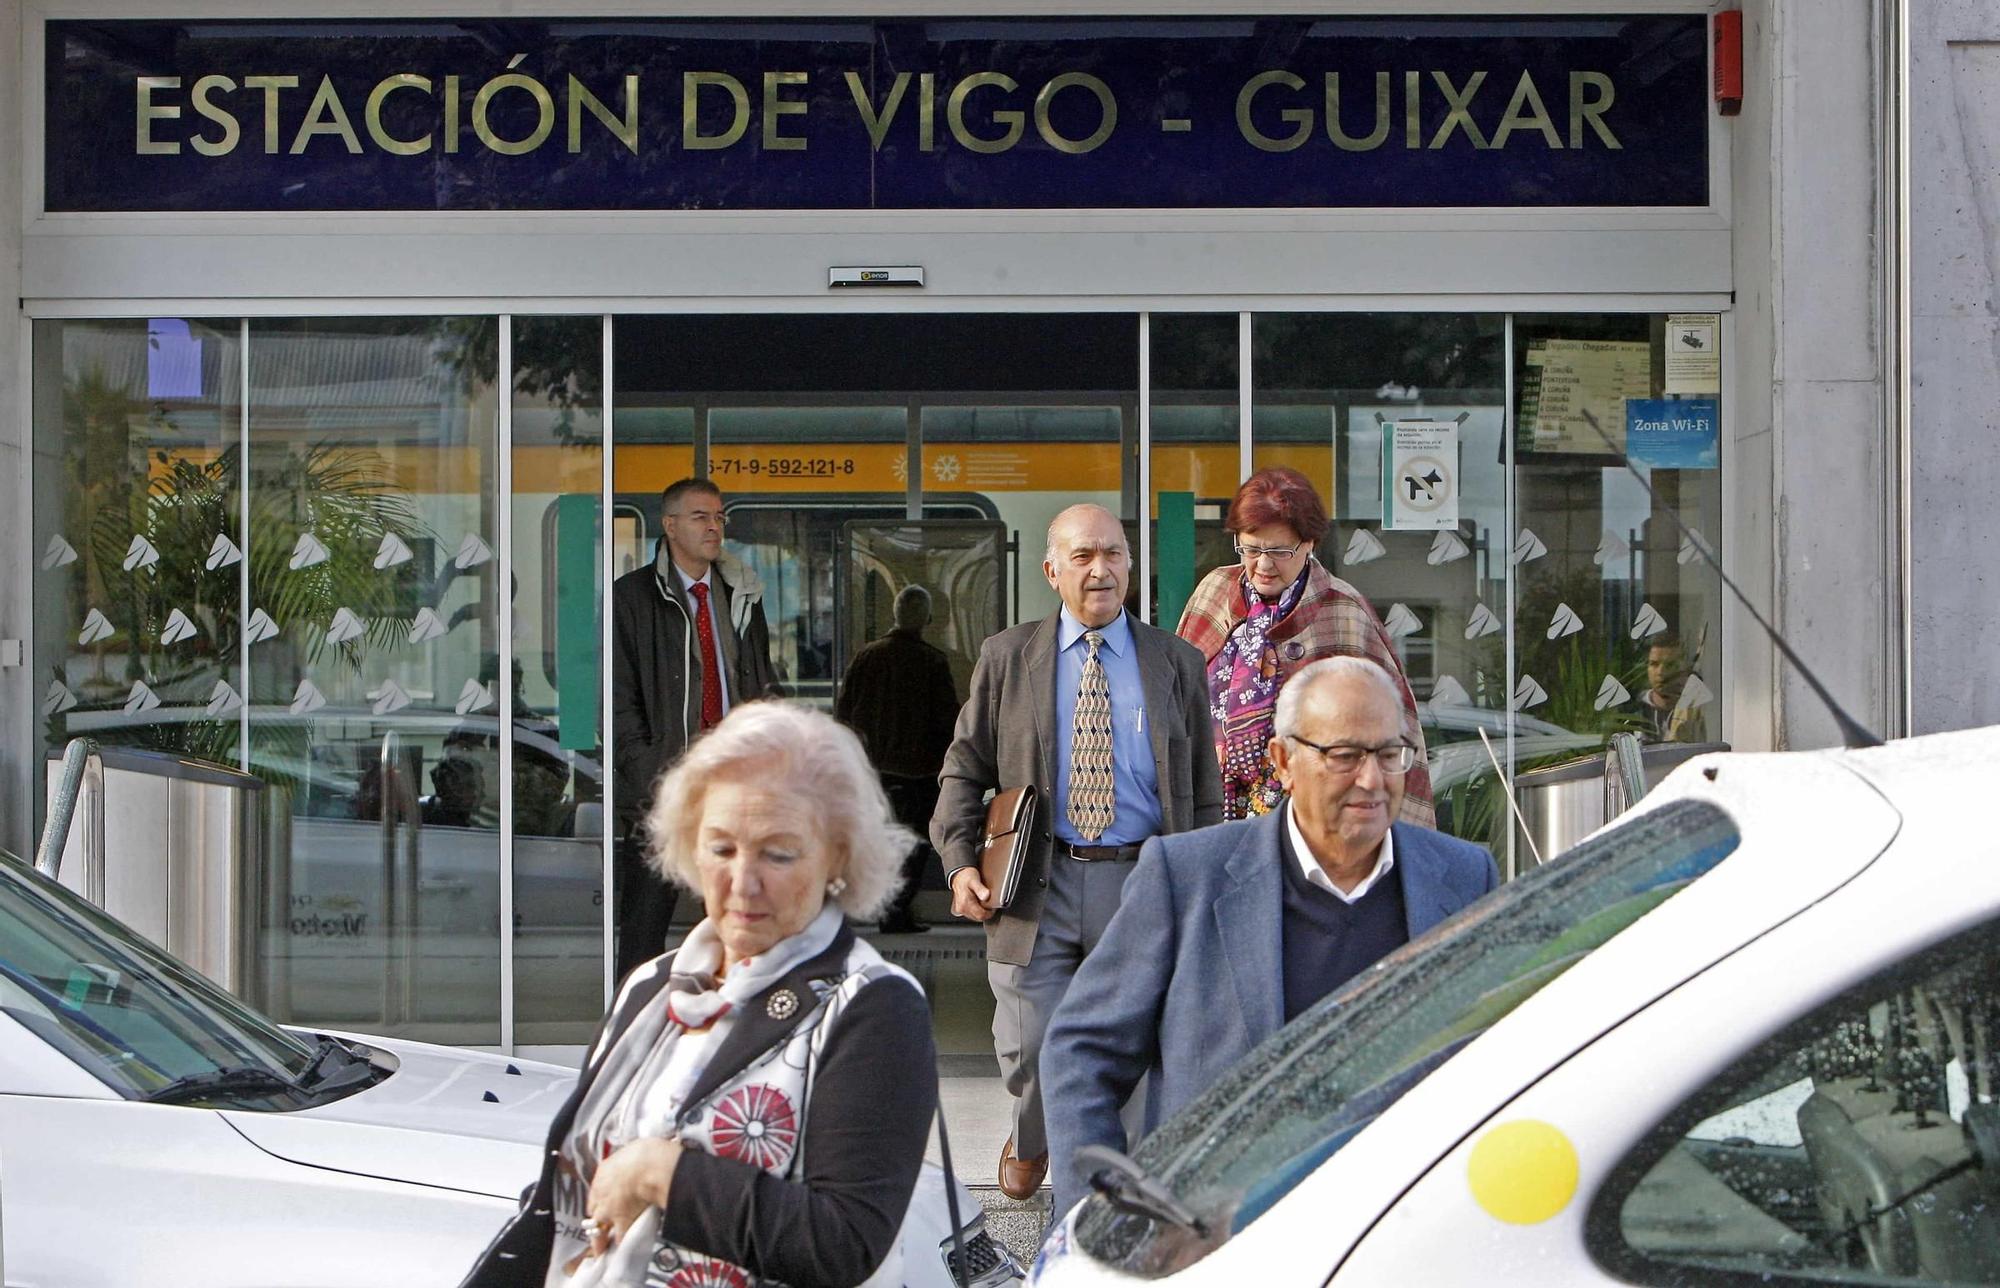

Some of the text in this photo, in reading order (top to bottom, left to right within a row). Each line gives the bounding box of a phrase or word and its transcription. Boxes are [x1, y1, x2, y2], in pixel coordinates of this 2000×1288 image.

[136, 53, 1624, 156] ESTACIÓN DE VIGO - GUIXAR
[1634, 418, 1710, 432] Zona Wi-Fi
